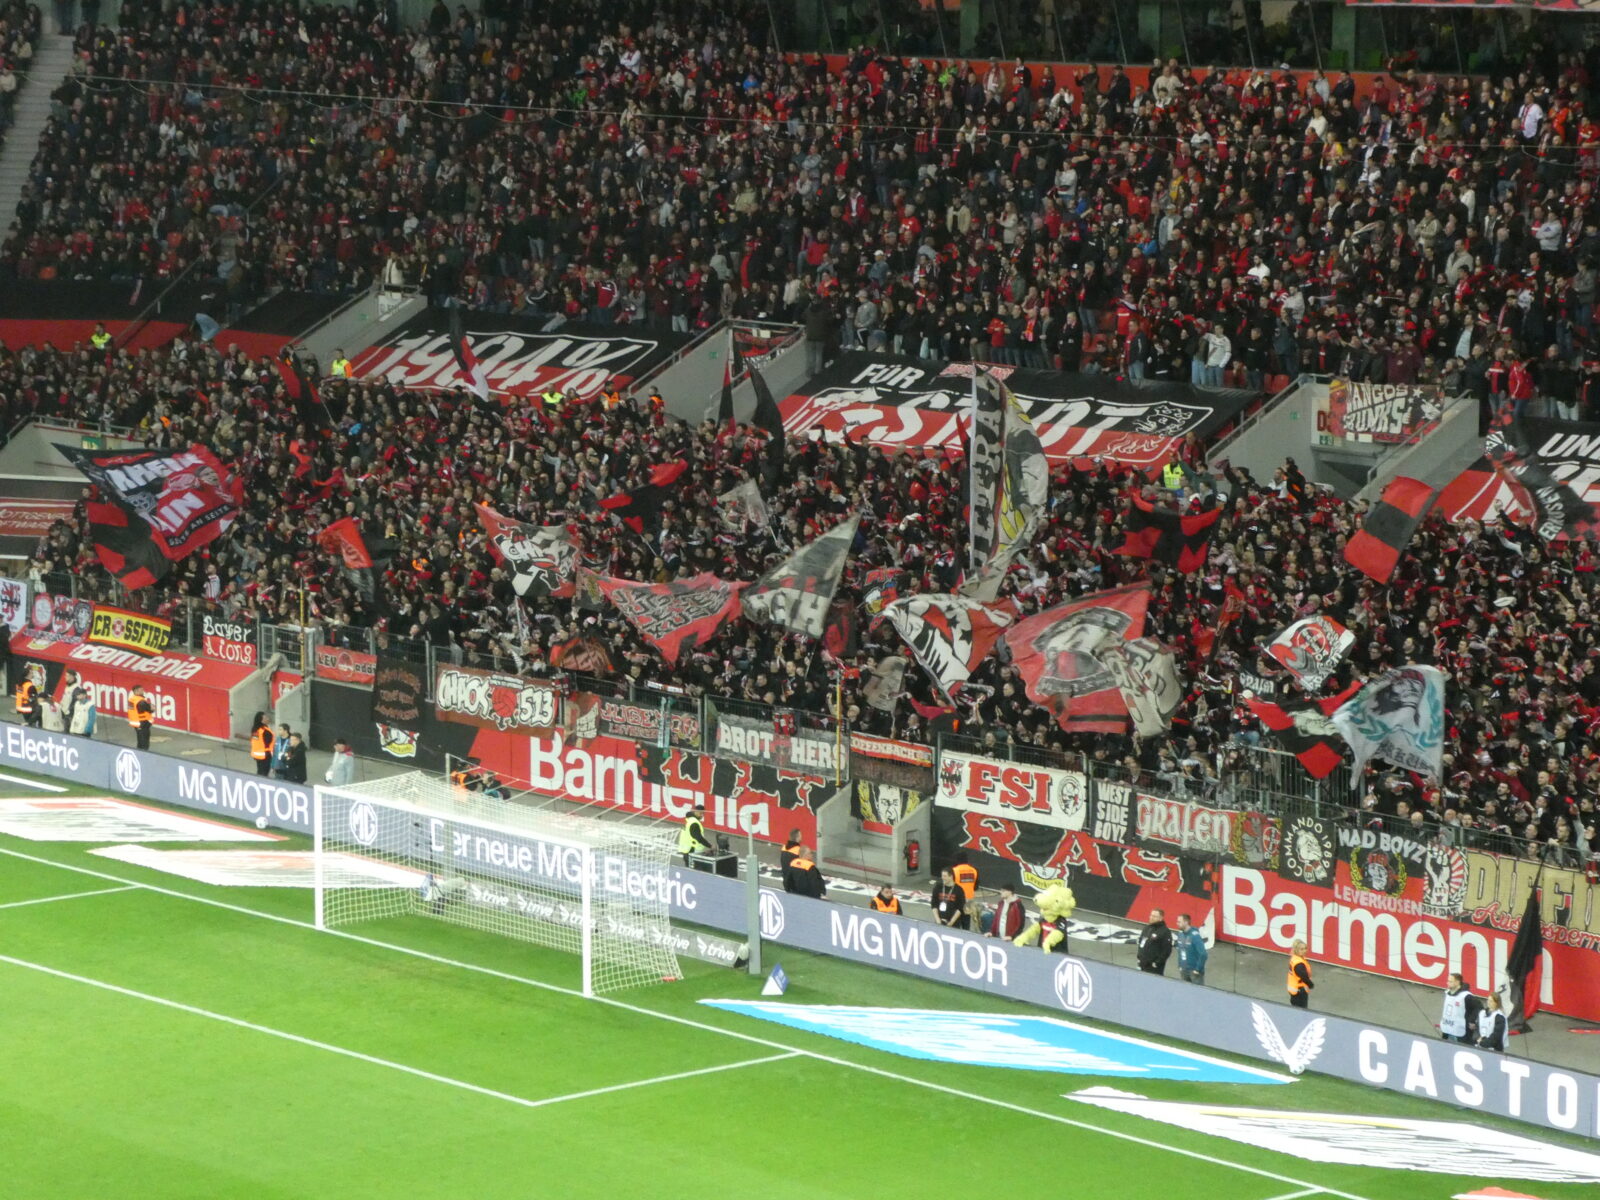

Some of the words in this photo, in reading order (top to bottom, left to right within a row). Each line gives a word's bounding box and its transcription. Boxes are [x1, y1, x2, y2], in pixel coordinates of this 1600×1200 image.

[851, 363, 925, 389] FÜR
[203, 615, 252, 643] Bayer
[518, 685, 555, 727] 513
[7, 727, 79, 771] Electric
[116, 754, 140, 788] MG
[966, 761, 1051, 812] FSI
[178, 765, 217, 805] MG
[222, 775, 309, 825] MOTOR
[1096, 802, 1128, 827] SIDE
[1097, 782, 1132, 806] WEST
[1284, 816, 1323, 877] COMMANDO
[1337, 827, 1376, 849] MAD
[1380, 832, 1427, 864] BOYZ
[475, 836, 532, 872] neue
[604, 855, 697, 910] Electric
[1334, 883, 1423, 917] LEVERKUSEN
[708, 943, 736, 961] trive
[830, 910, 884, 956] MG
[891, 923, 1009, 986] MOTOR
[1056, 965, 1091, 1006] MG
[1358, 1029, 1600, 1137] CASTO
